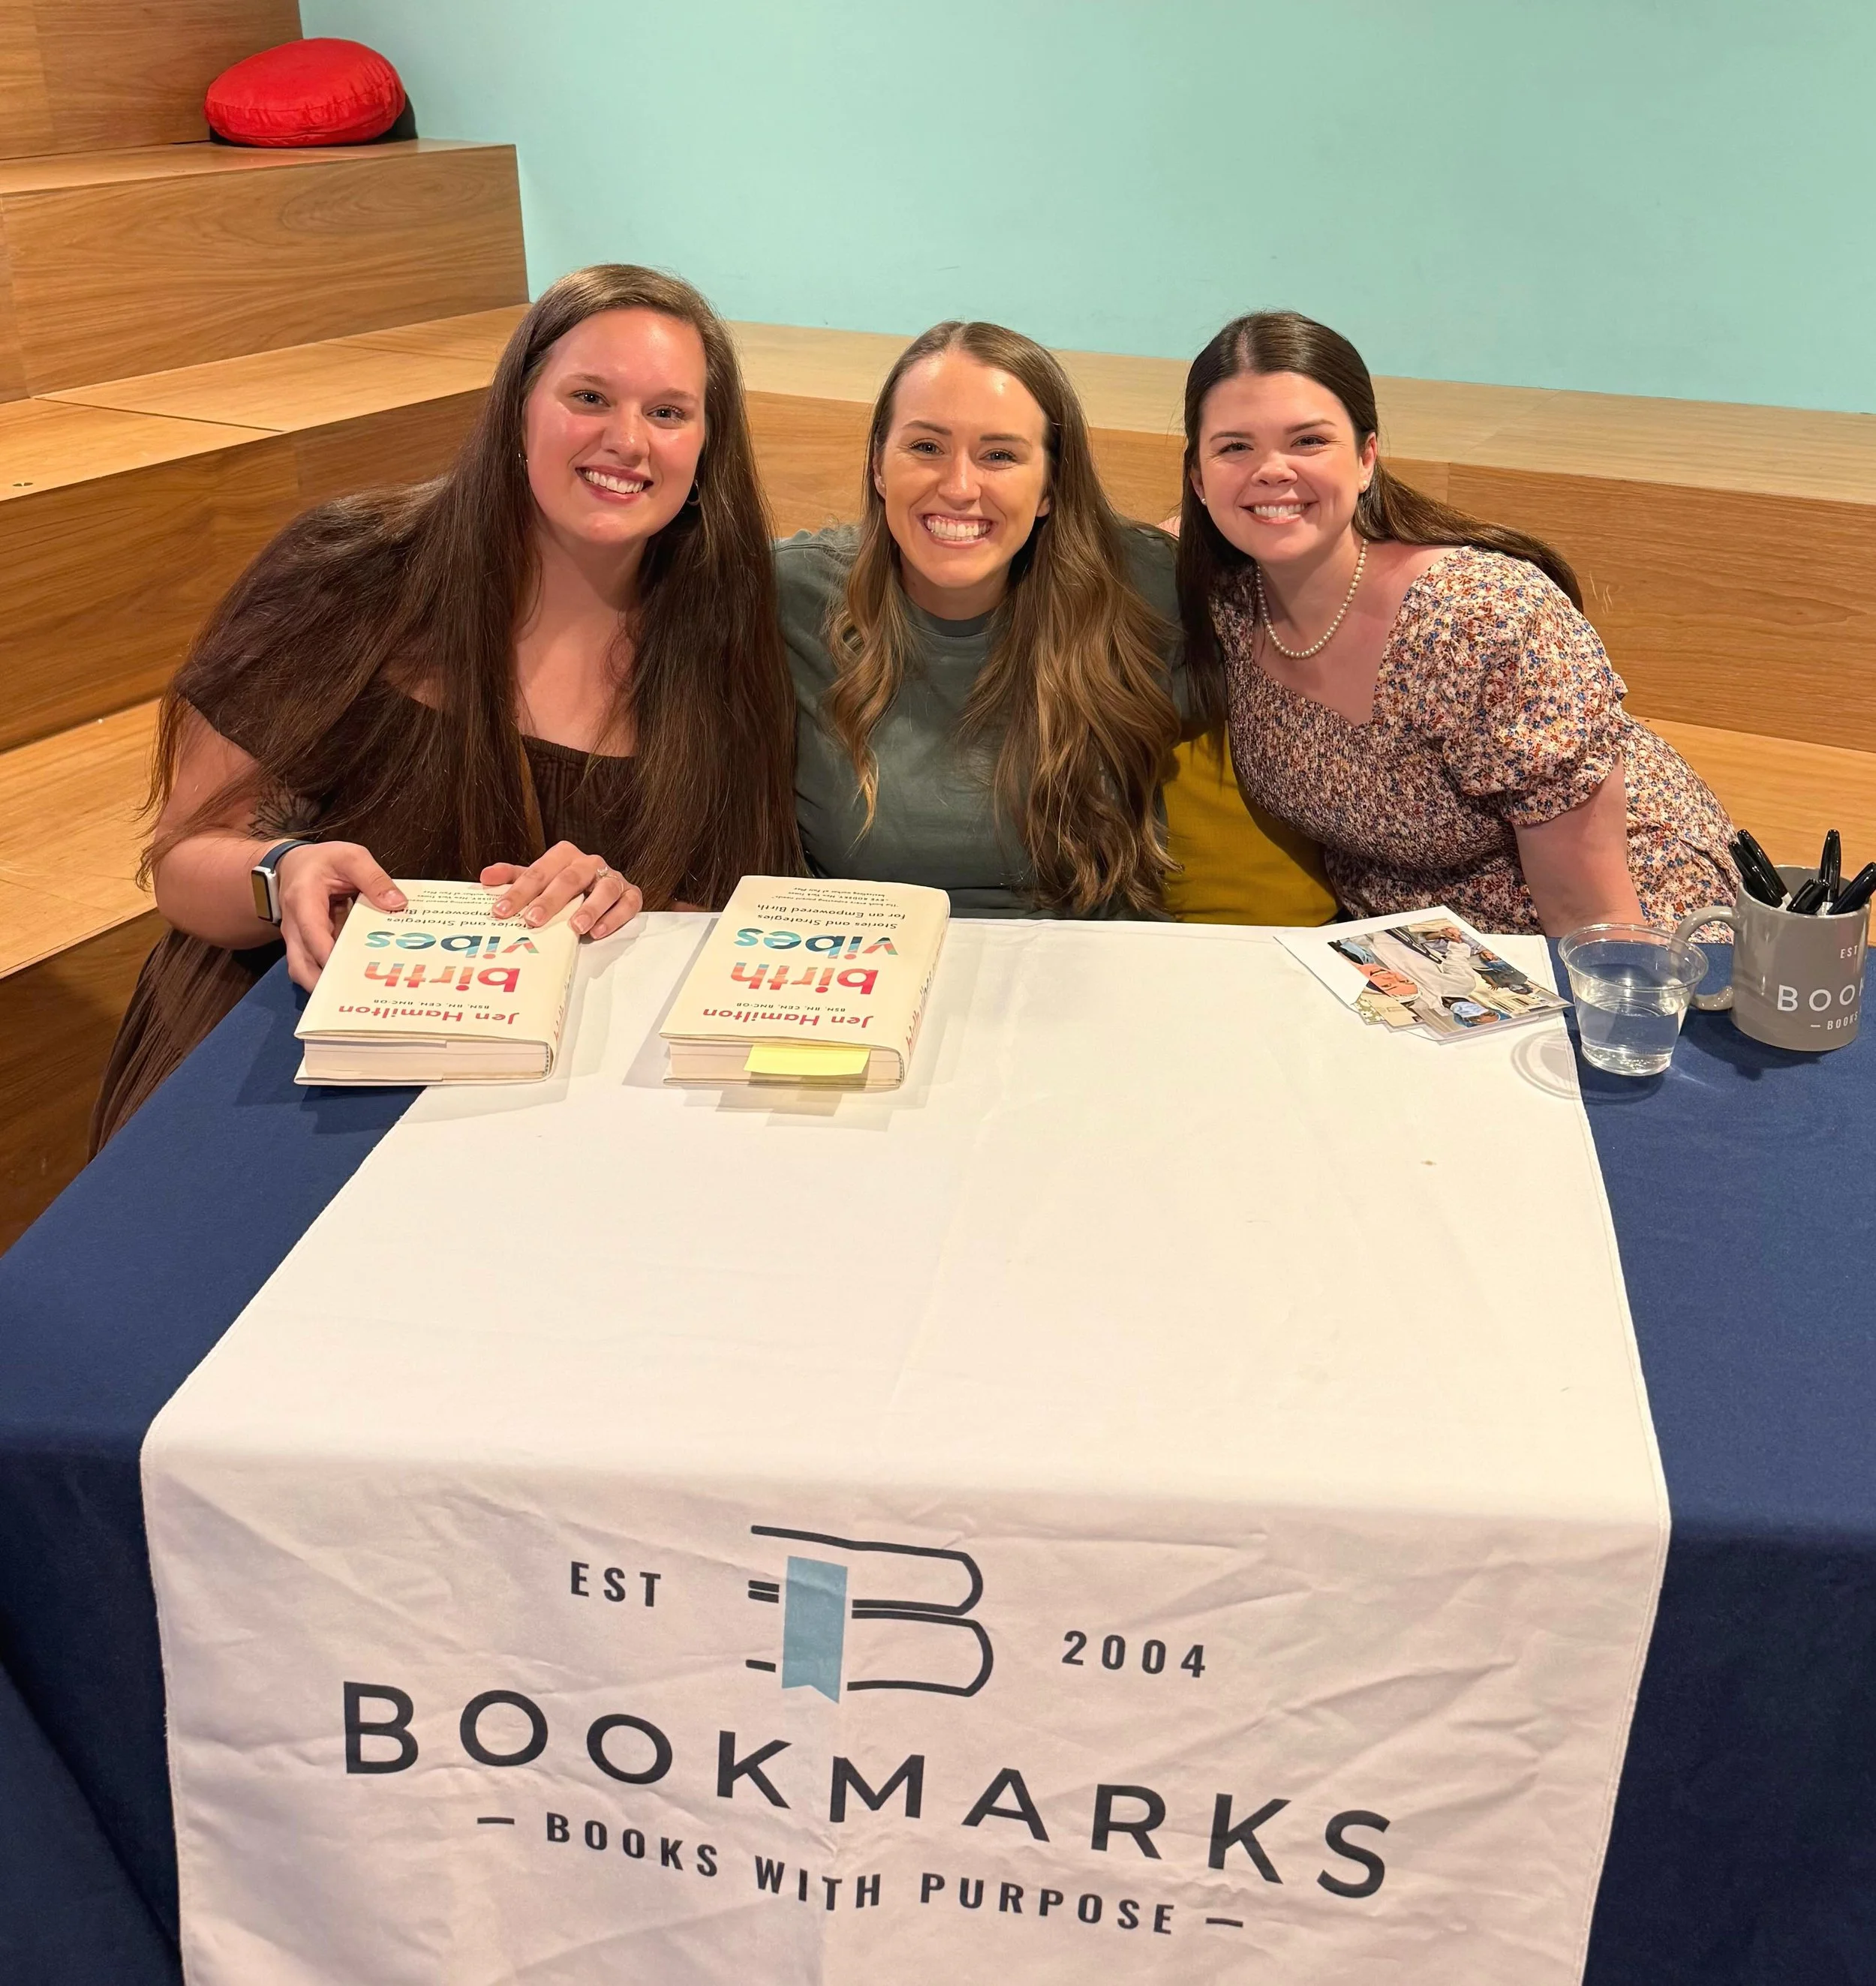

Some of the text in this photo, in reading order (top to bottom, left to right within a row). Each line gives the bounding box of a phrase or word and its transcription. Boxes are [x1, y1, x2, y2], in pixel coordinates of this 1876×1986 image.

[422, 909, 495, 918] mpowered
[757, 904, 786, 913] Birth
[791, 907, 864, 918] Empowered
[387, 918, 455, 926] Strategies
[757, 915, 822, 926] Strategies
[364, 931, 540, 960] vibes
[733, 928, 898, 960] vibes
[1840, 945, 1858, 959] EST
[364, 962, 520, 993] birth
[731, 962, 879, 995] birth
[338, 1005, 520, 1025] Jen Hamilton
[702, 1009, 873, 1028] Jen Hamilton
[1827, 1011, 1858, 1030] BOOKS
[570, 1561, 1206, 1678] EST 2004
[344, 1681, 1391, 1899] BOOKMARKS
[546, 1811, 1174, 1935] BOOKS WITH PURPOSE
